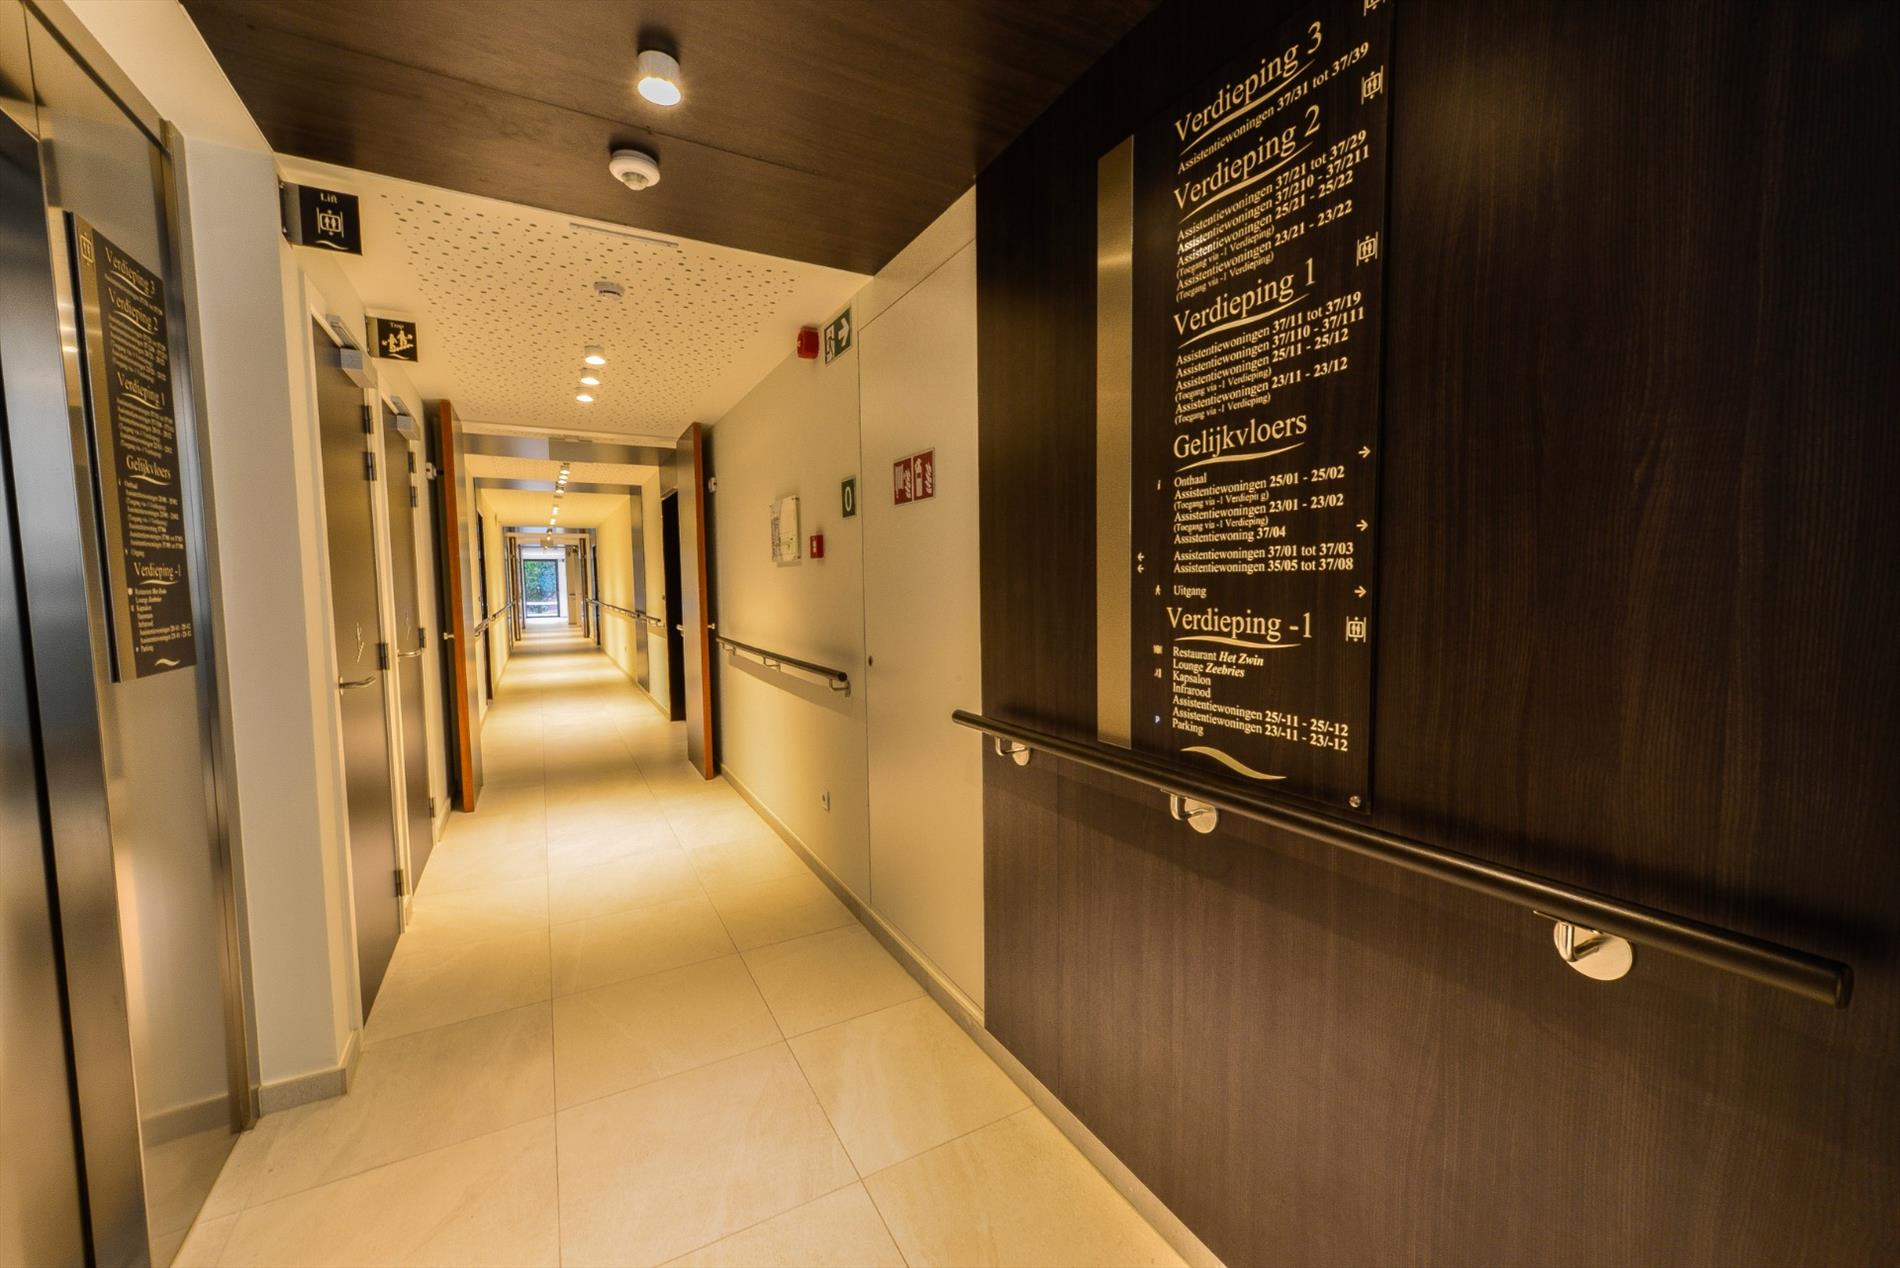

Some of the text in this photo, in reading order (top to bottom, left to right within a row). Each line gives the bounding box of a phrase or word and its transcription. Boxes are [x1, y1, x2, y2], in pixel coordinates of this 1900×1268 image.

[1174, 21, 1322, 142] Verdieping 3
[1177, 41, 1369, 175] Assistentiewoningen 37/31 tot 37/39
[1174, 104, 1320, 210] Verdieping 2
[321, 192, 337, 204] Lift
[1177, 129, 1366, 241] Assistentiewoningen 37/21 tot 37/29
[1177, 200, 1272, 254] Assistentiewoningen
[1275, 176, 1314, 205] 37/210
[1326, 145, 1369, 178] 37/211
[1177, 214, 1272, 268] Assistentiewoningen
[1275, 194, 1305, 220] 25/21
[1318, 170, 1353, 199] 25/22
[1177, 240, 1272, 291] Assistentiewoningen
[1274, 222, 1305, 246] 23/21
[1318, 199, 1352, 227] 23/22
[106, 247, 150, 296] Verdieping
[150, 280, 156, 295] 3
[108, 288, 153, 332] Verdieping
[153, 317, 158, 331] 2
[1174, 257, 1316, 336] Verdieping 1
[1176, 291, 1361, 366] Assistentiewoningen 37/11 tot 37/19
[1176, 341, 1270, 379] Assistentiewoningen
[1272, 325, 1310, 348] 37/110
[1322, 306, 1364, 332] 37/111
[1176, 355, 1269, 391] Assistentiewoningen
[1272, 342, 1302, 362] 25/11
[1314, 327, 1349, 350] 25/12
[117, 371, 165, 407] Verdieping 1
[1176, 382, 1268, 414] Assistentiewoningen
[1271, 370, 1301, 389] 23/11
[1314, 356, 1348, 378] 23/12
[1173, 414, 1307, 459] Gelijkvloers
[126, 455, 171, 479] Gelijkvloers
[1174, 473, 1207, 487] Onthaal
[1174, 479, 1267, 500] Assistentiewoningen
[1269, 472, 1299, 488] 25/01
[1311, 465, 1344, 482] 25/02
[1174, 504, 1266, 523] Assistentiewoningen
[1269, 499, 1298, 513] 23/01
[1310, 493, 1344, 509] 23/02
[1174, 526, 1286, 545] Assistentiewoning 37/04
[1174, 542, 1353, 562] Assistentiewoningen 37/01 tot 37/03
[134, 562, 181, 580] Verdieping -1
[1174, 558, 1353, 574] Assistentiewoningen 35/05 tot 37/08
[1173, 585, 1207, 598] Uitgang
[1167, 607, 1312, 642] Verdieping -1
[1173, 646, 1264, 667] Restaurant Het Zwin
[1173, 659, 1245, 678] Lounge Zeebries
[1173, 671, 1211, 686] Kapsalon
[1173, 684, 1211, 698] Infrarood
[1172, 695, 1262, 721] Assistentiewoningen
[1265, 711, 1299, 727] 25/-11
[1310, 718, 1348, 736] 25/-12
[1172, 719, 1203, 736] Parking
[1172, 707, 1262, 734] Assistentiewoningen
[1265, 725, 1298, 741] 23/-11
[1310, 733, 1348, 752] 23/-12
